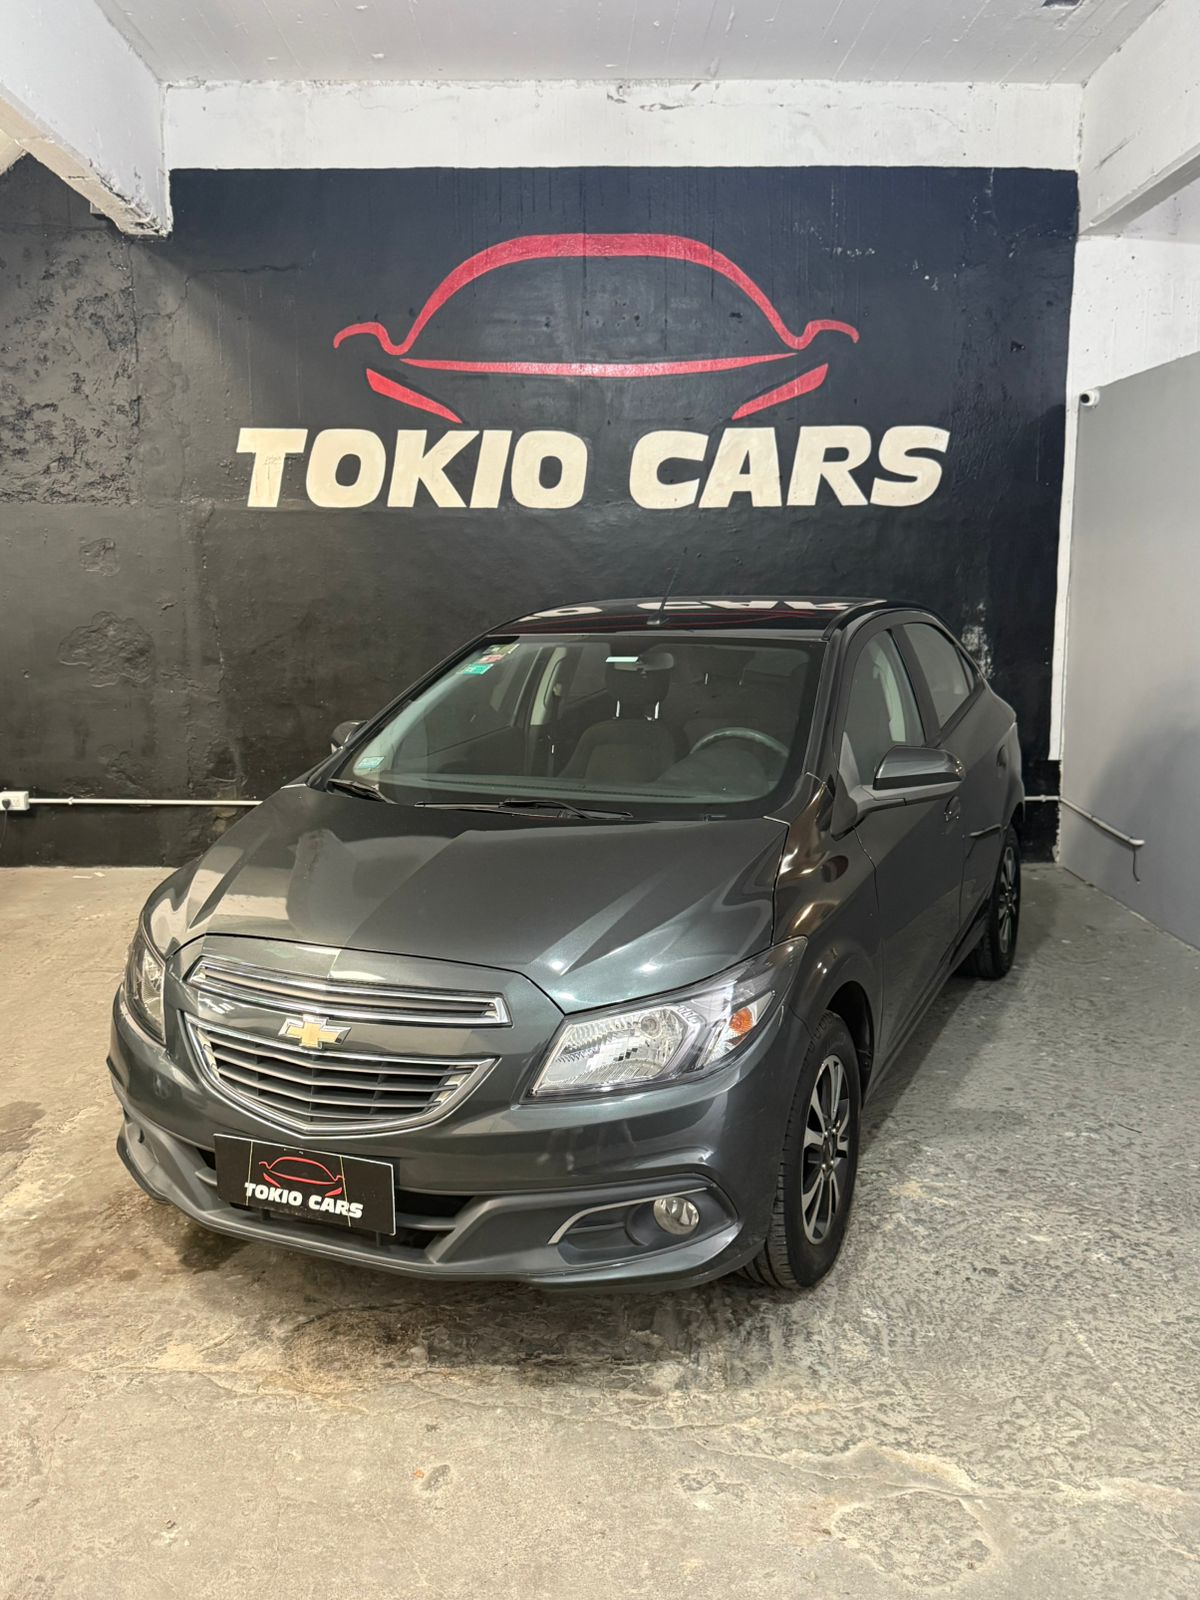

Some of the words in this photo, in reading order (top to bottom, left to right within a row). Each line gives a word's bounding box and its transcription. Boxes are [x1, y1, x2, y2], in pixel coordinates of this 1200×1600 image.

[236, 428, 588, 510] TOKIO
[629, 426, 951, 509] CARS
[244, 1182, 303, 1206] TOKIO
[308, 1195, 364, 1219] CARS
